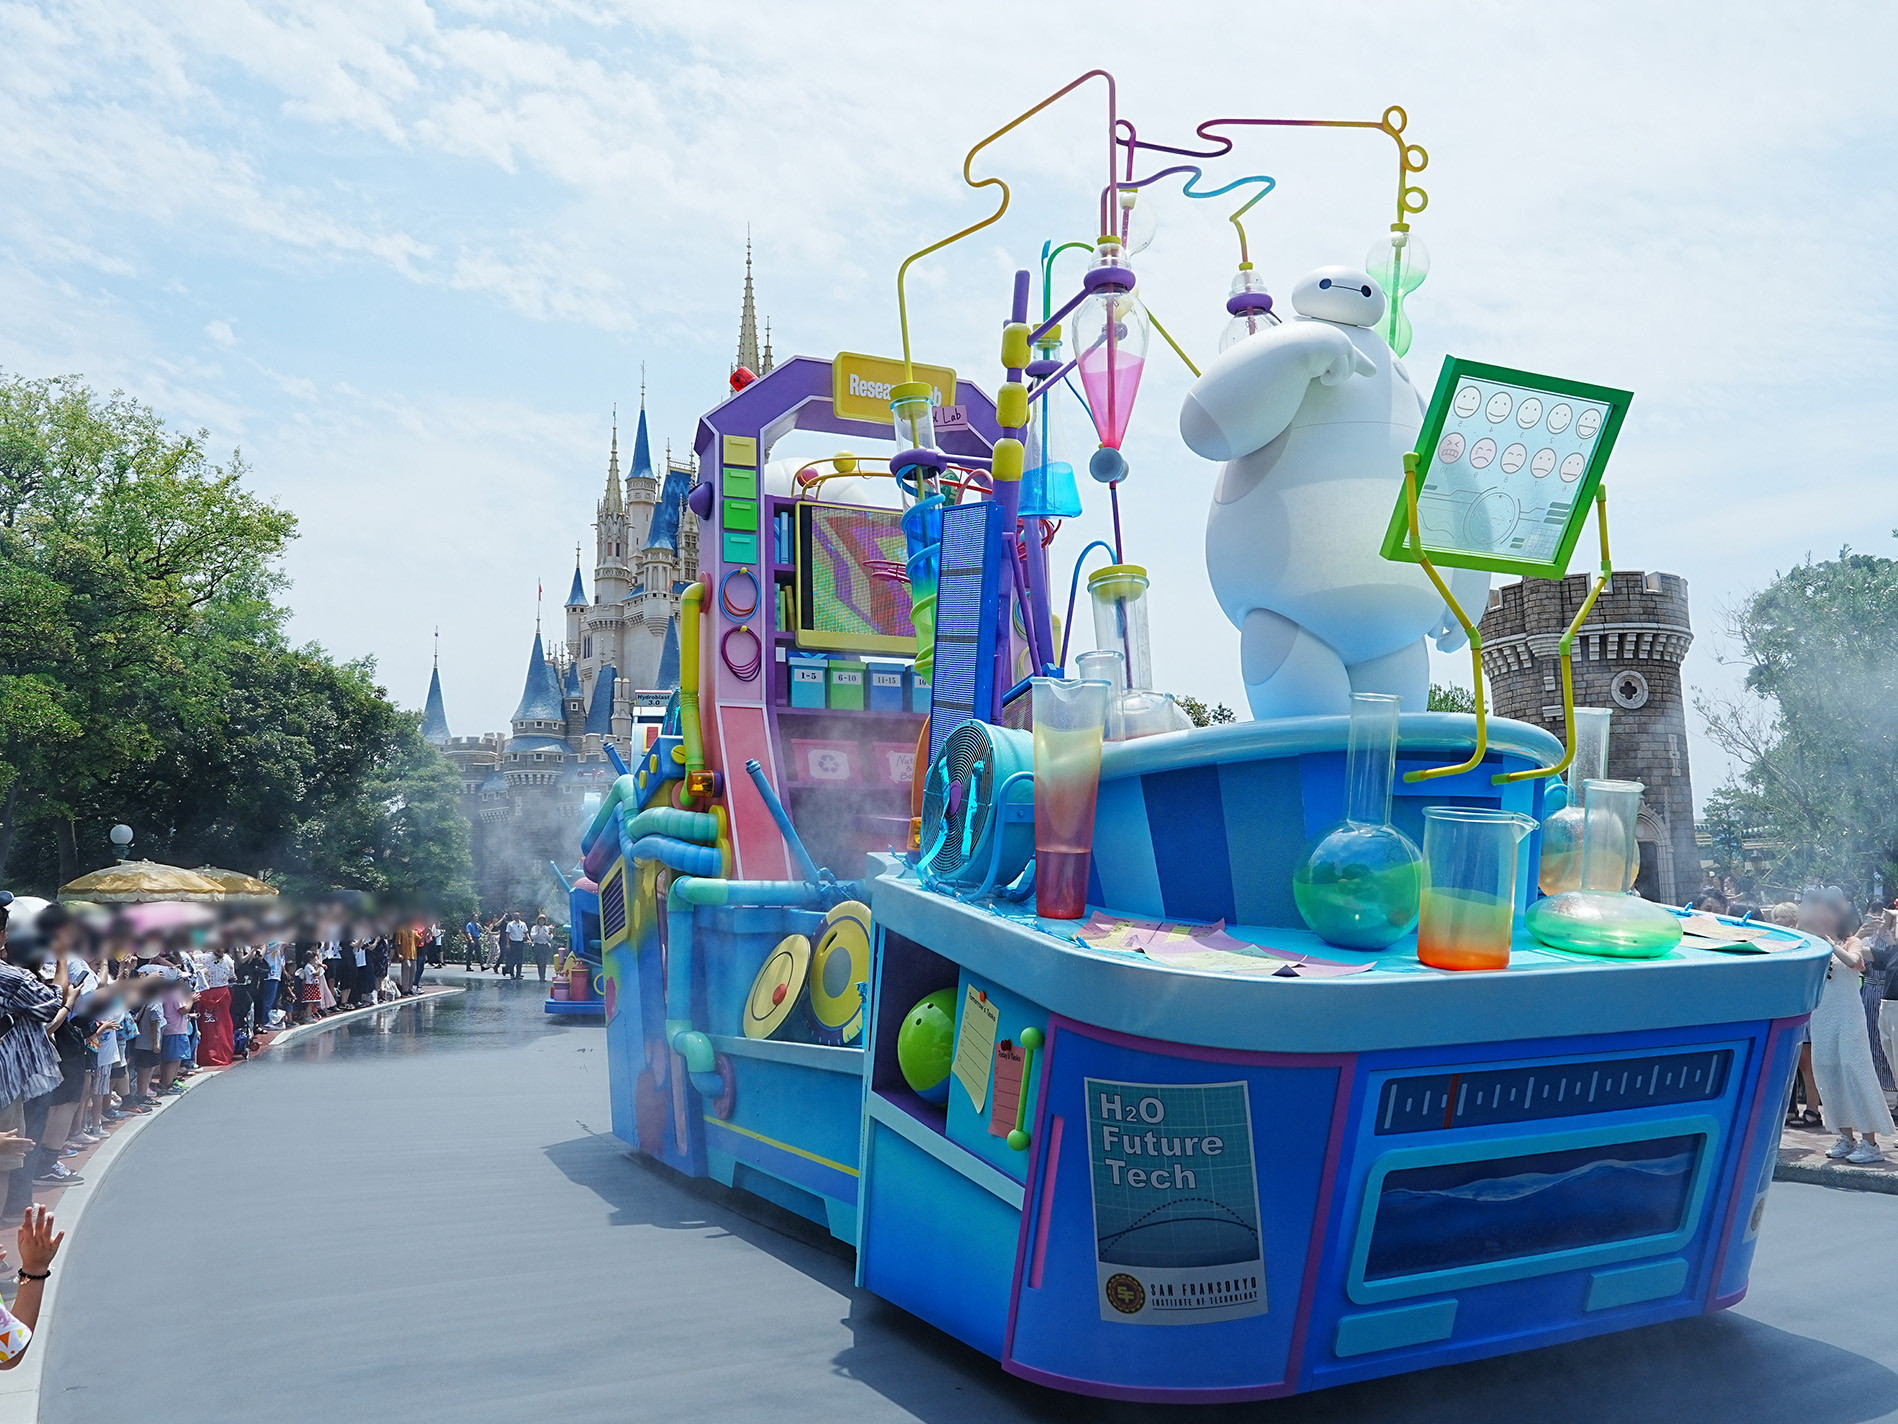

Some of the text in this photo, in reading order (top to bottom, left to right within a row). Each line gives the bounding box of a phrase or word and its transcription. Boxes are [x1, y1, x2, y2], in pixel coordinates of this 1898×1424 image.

[849, 373, 898, 401] Resea
[942, 407, 961, 424] Lab
[801, 672, 817, 680] 1-5
[838, 674, 857, 682] 6-10
[877, 676, 896, 684] 11-15
[896, 755, 913, 767] Nut
[1102, 1125, 1224, 1156] Future
[1104, 1158, 1197, 1189] Tech
[1151, 1276, 1257, 1297] SAN FRANSOKYO
[1152, 1291, 1258, 1306] INSTITUTE OF TECHNOLOGY
